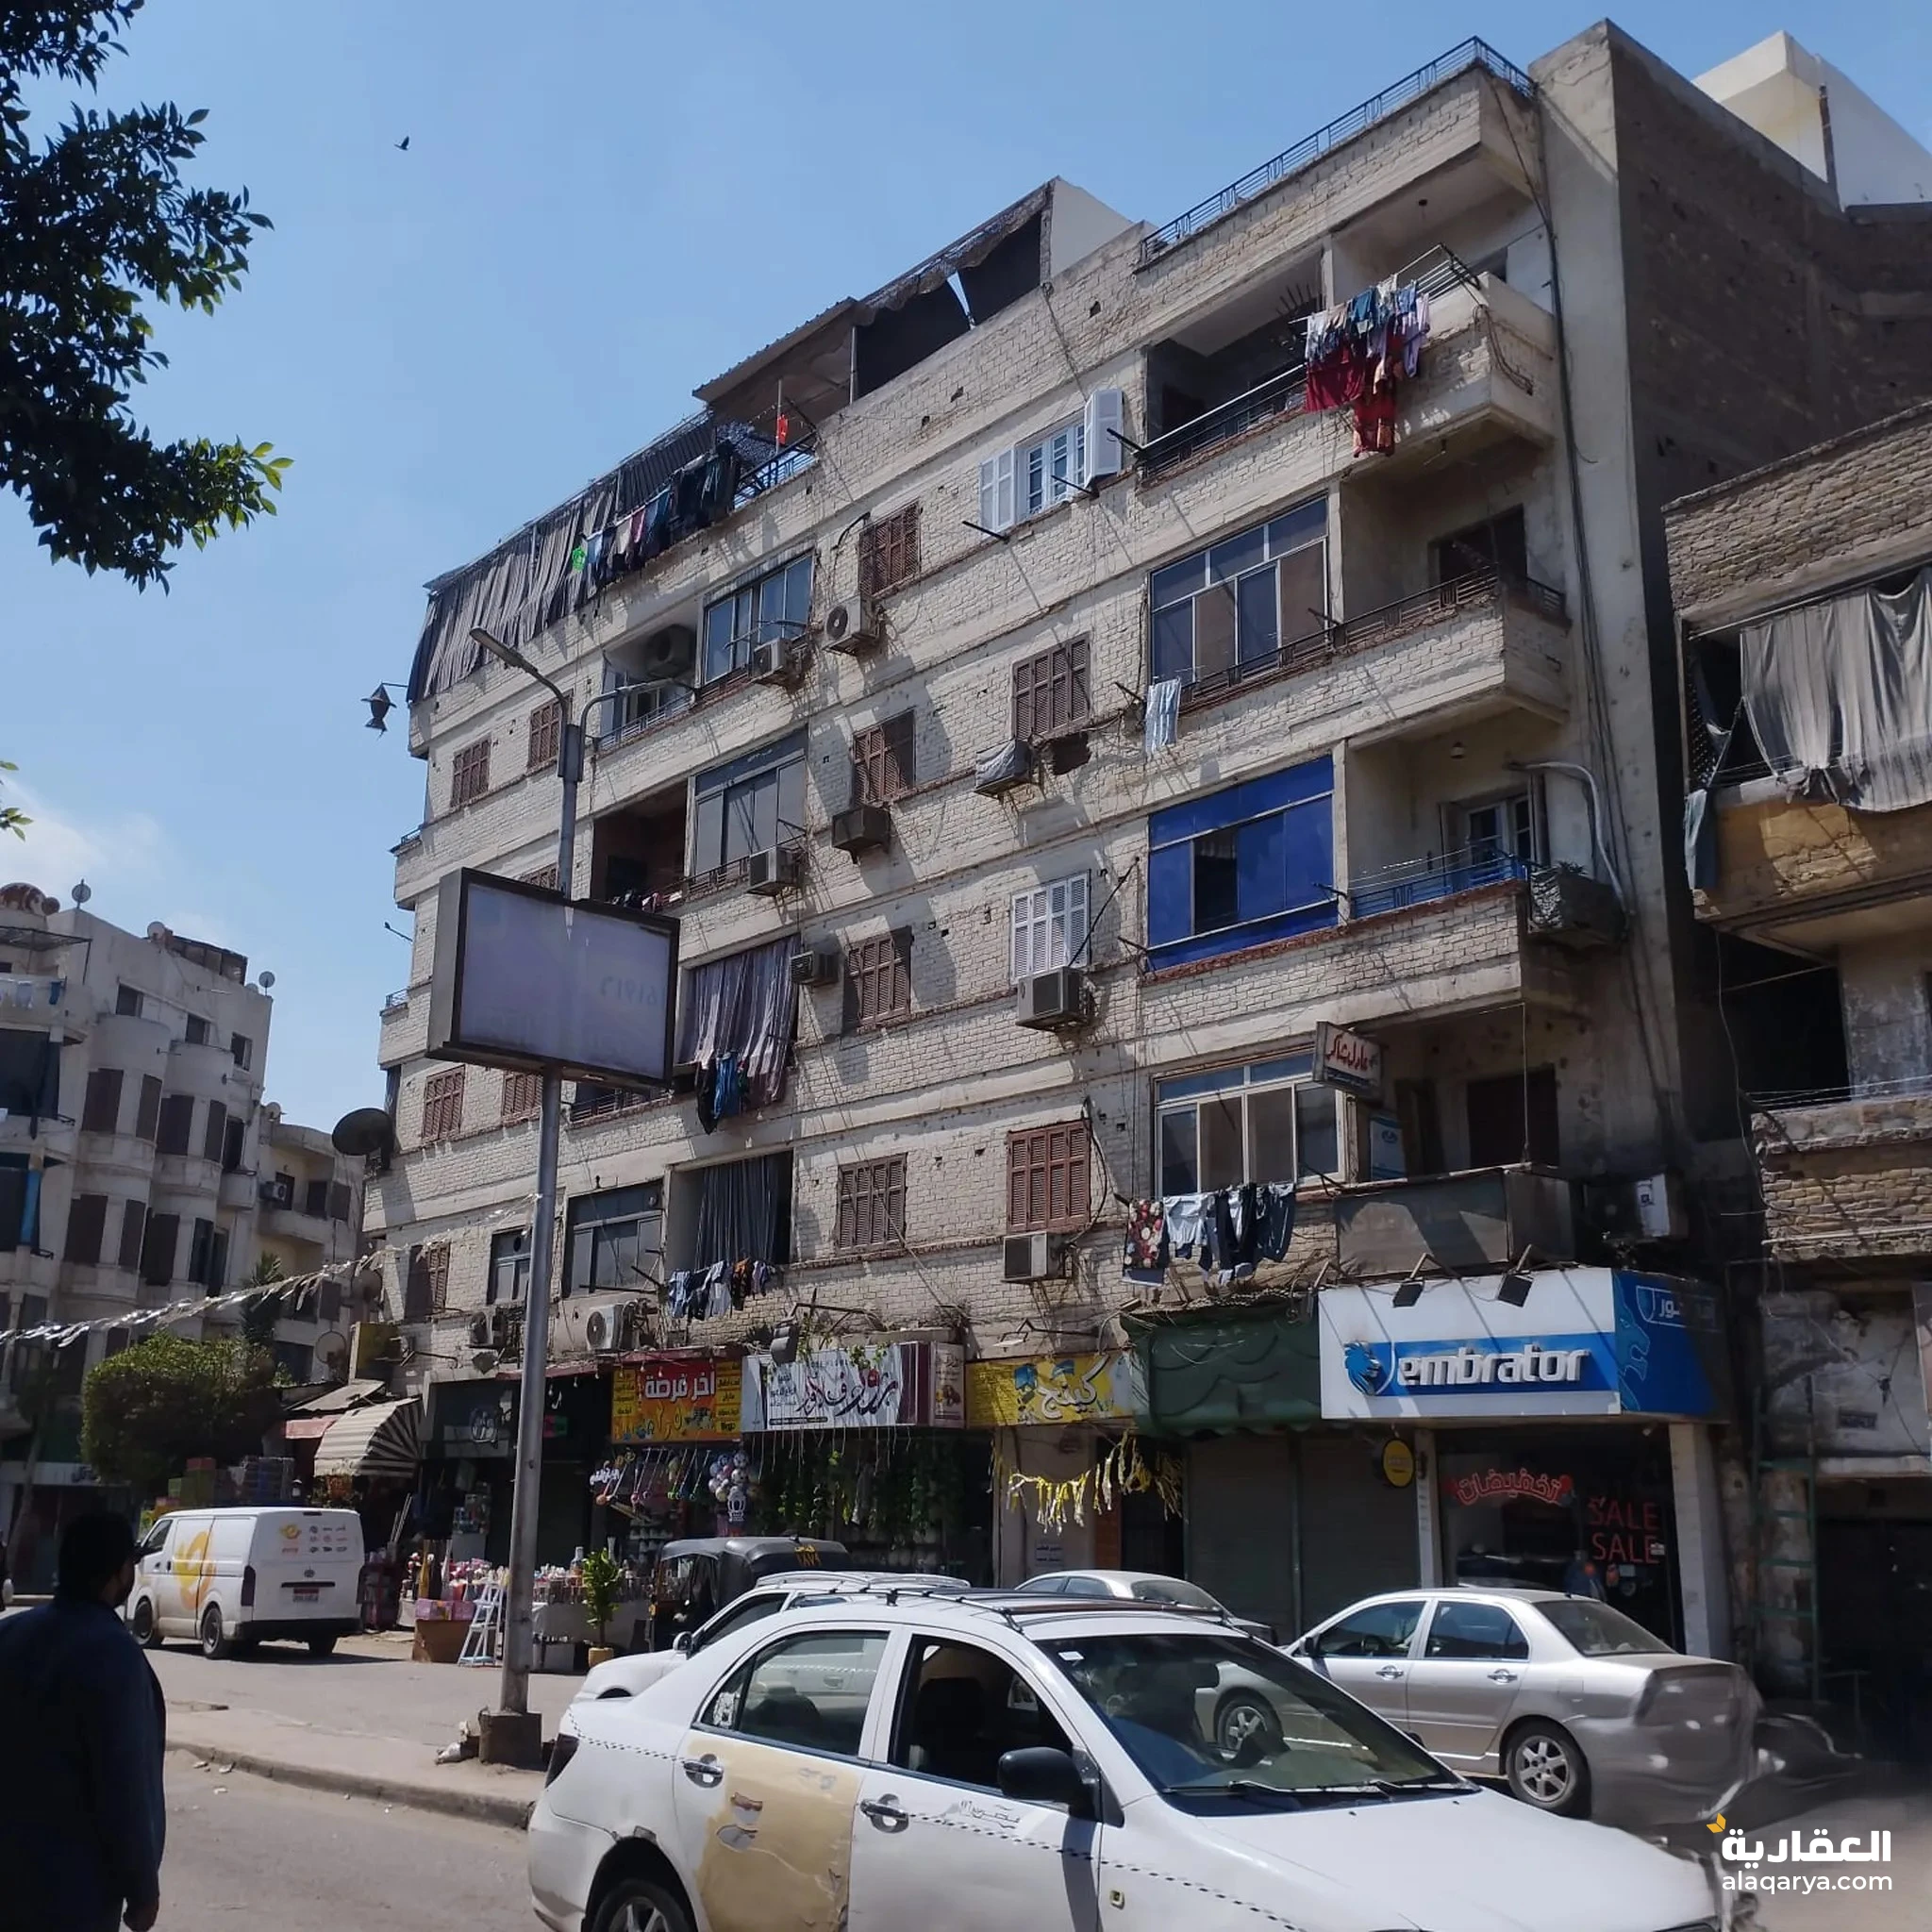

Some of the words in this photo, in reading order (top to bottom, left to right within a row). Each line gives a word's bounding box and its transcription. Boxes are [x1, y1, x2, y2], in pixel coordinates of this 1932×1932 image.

[1397, 1343, 1591, 1387] embrator
[644, 1373, 689, 1402] فرصة
[1038, 1352, 1110, 1420] كينج
[1456, 1467, 1563, 1507] تخفيضات
[1588, 1497, 1660, 1530] SALE
[1591, 1532, 1661, 1563] SALE
